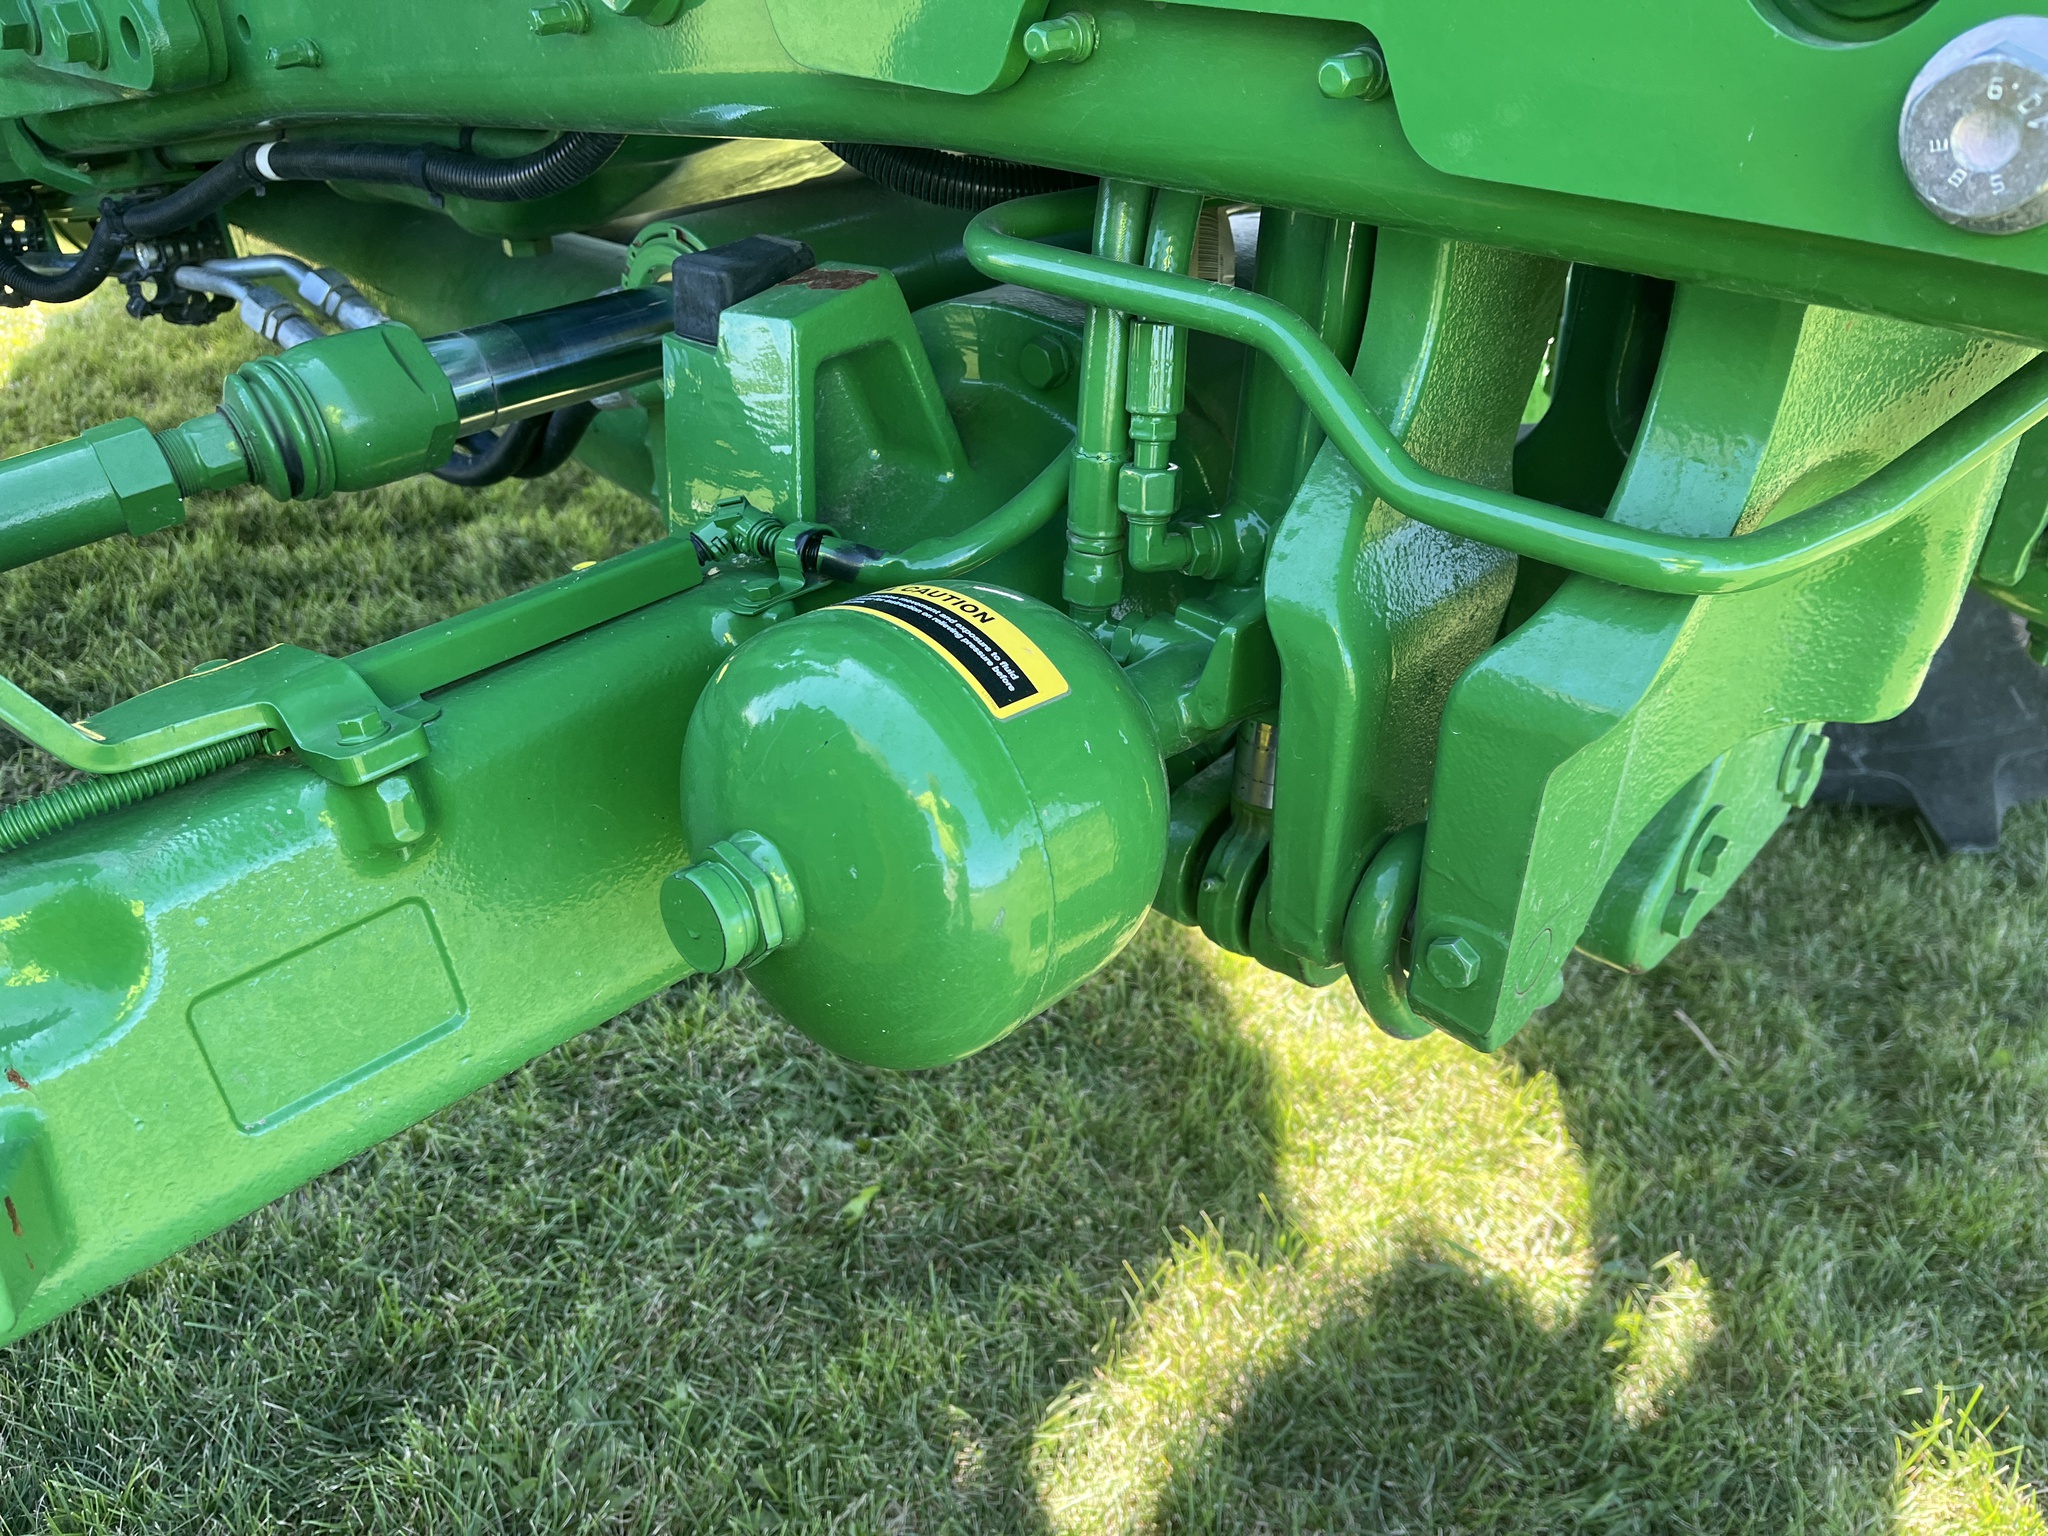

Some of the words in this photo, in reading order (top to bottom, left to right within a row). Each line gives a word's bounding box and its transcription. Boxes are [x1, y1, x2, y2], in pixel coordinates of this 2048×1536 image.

[901, 587, 995, 624] CAUTION
[931, 617, 964, 640] relieving
[960, 637, 994, 667] pressure
[991, 665, 1016, 692] before
[939, 613, 958, 624] and
[955, 621, 992, 653] exposure
[990, 651, 1001, 662] to
[999, 661, 1020, 681] fluid
